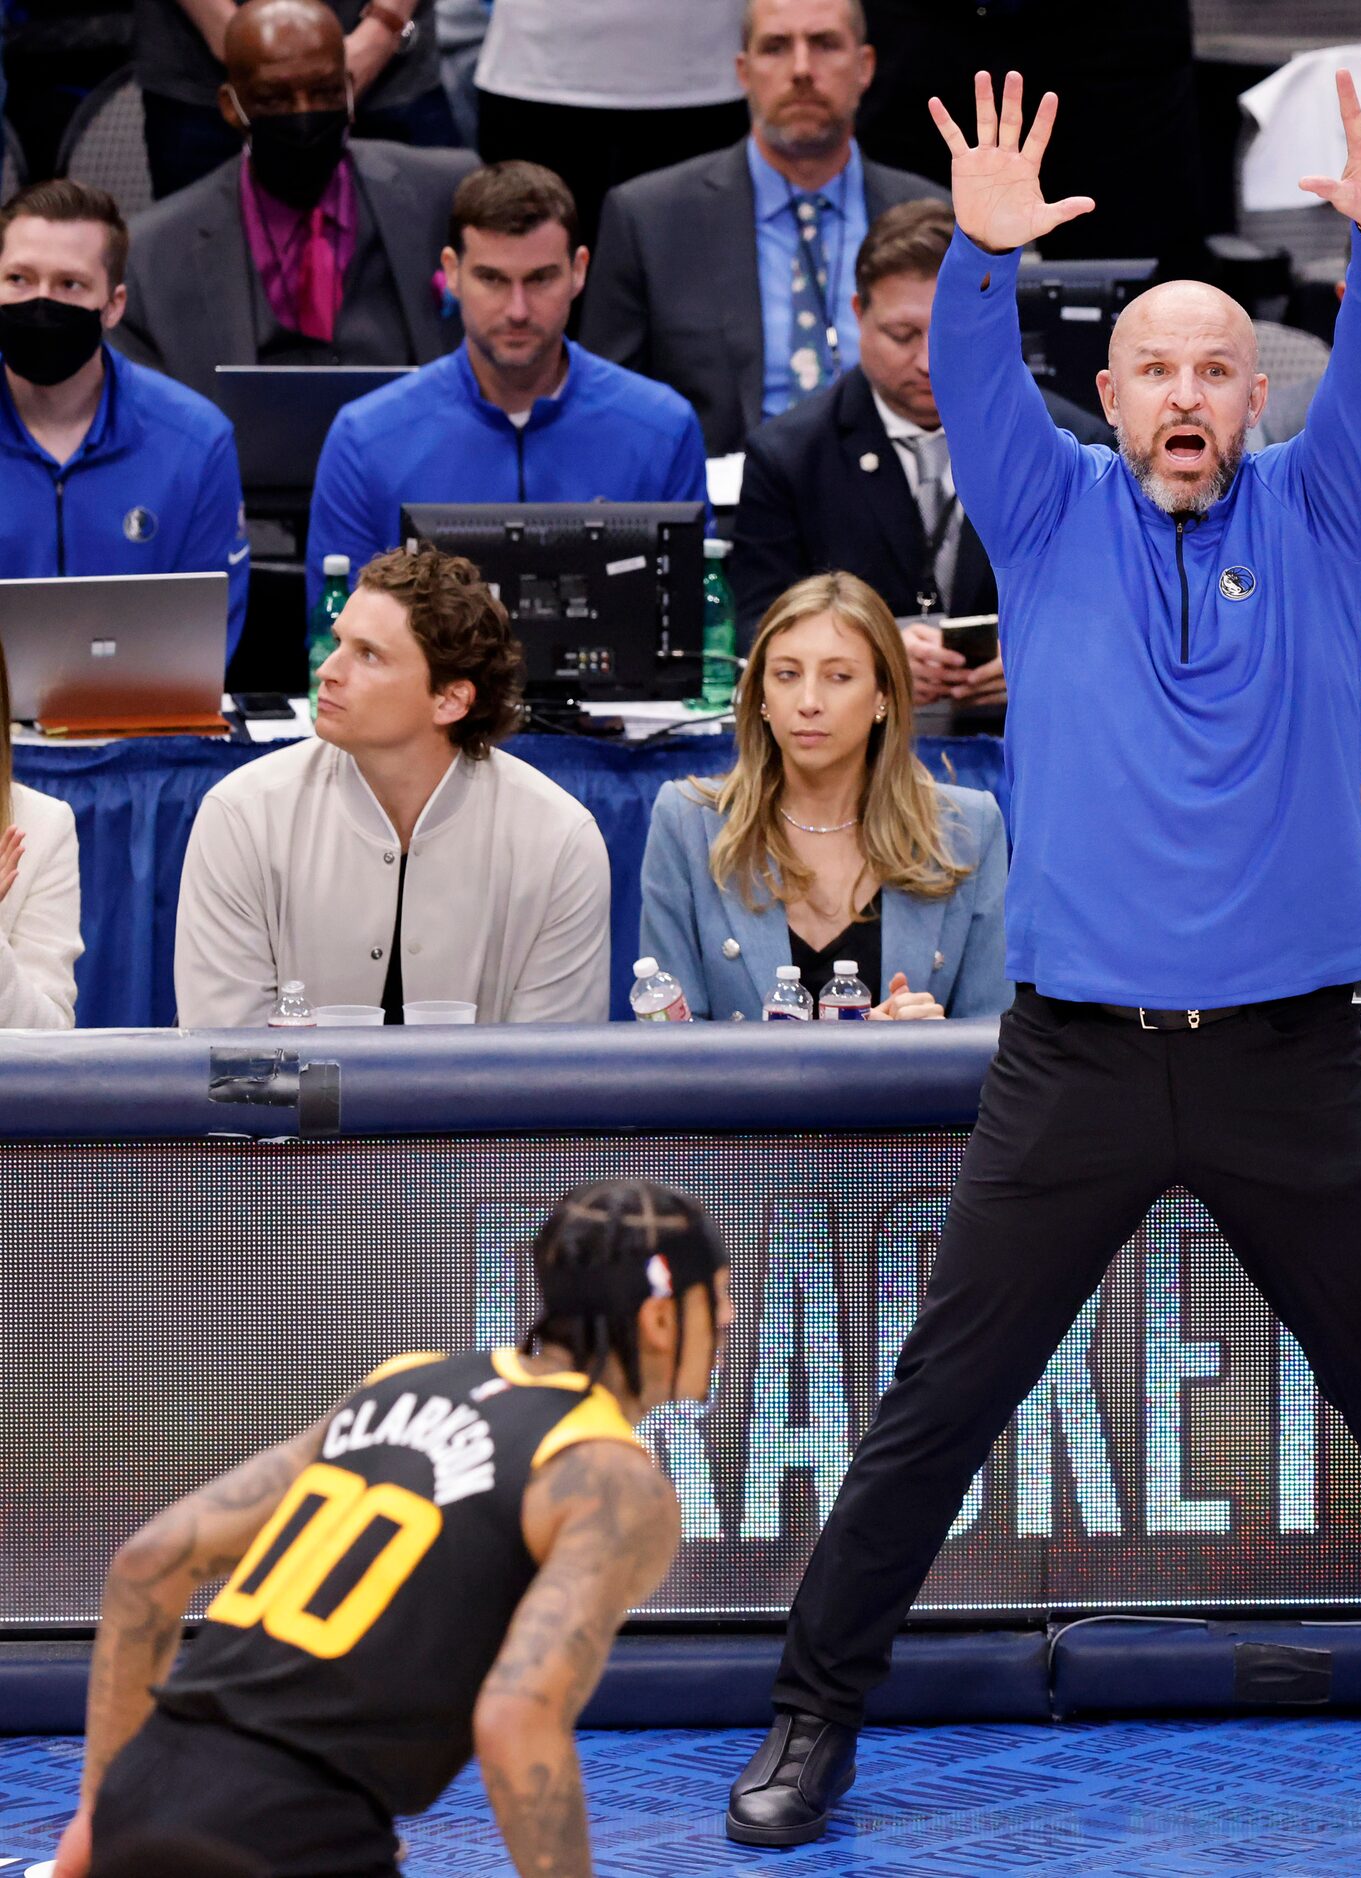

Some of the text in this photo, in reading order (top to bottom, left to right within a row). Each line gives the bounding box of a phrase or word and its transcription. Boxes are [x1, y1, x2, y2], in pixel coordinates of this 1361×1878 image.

[323, 1392, 497, 1507] CLARKSON
[206, 1462, 445, 1660] 00
[646, 1733, 768, 1779] JAS
[872, 1726, 1060, 1768] JAMAL
[632, 1775, 731, 1804] BROO
[1021, 1752, 1245, 1794] MONTA ELLIS
[1128, 1749, 1345, 1791] DEJUAN BLAIR
[812, 1765, 1083, 1845] ACKMAN
[1087, 1785, 1226, 1813] KHALID
[910, 1824, 1127, 1873] TERRY
[1180, 1834, 1337, 1867] GREEN
